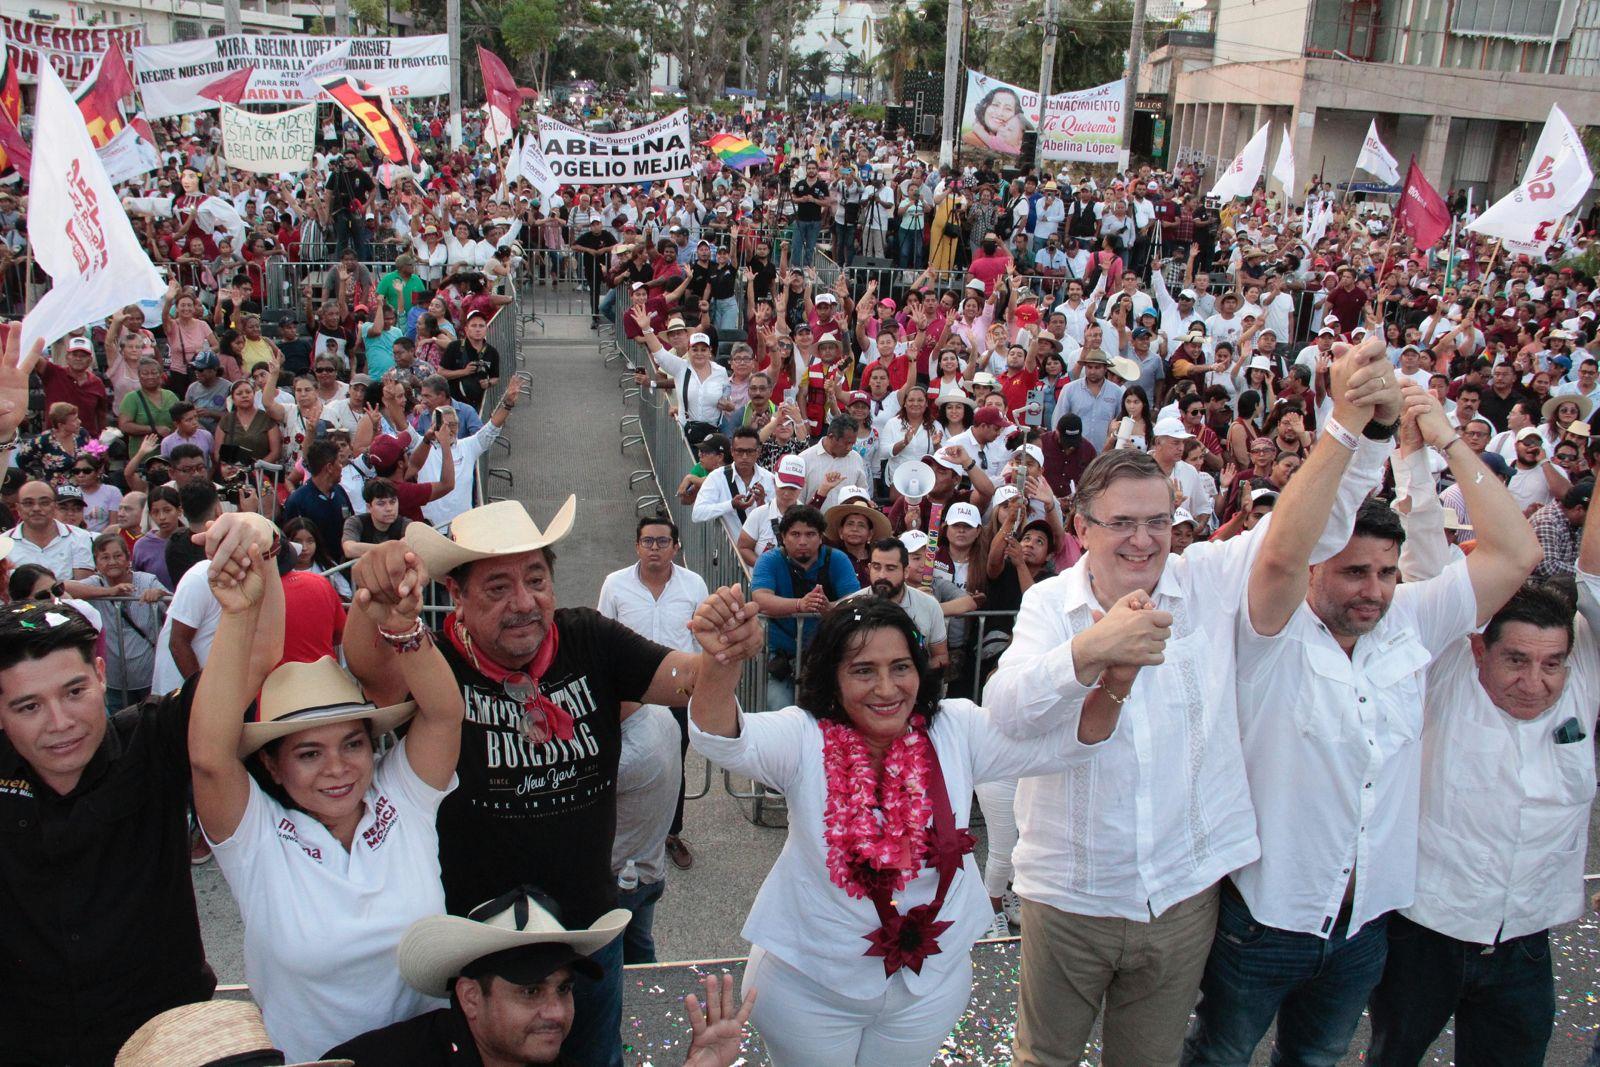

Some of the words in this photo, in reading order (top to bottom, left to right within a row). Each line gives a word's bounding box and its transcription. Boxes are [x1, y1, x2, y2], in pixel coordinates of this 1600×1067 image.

[215, 37, 252, 58] MTRA.
[254, 38, 299, 57] ABELINA
[140, 68, 176, 84] RECIBE
[178, 60, 225, 79] NUESTRO
[227, 57, 260, 71] APOYO
[263, 58, 290, 71] PARA
[292, 58, 305, 71] LA
[374, 58, 386, 70] DE
[388, 58, 400, 69] TU
[255, 129, 277, 143] CON
[647, 122, 670, 136] Mejor
[1043, 115, 1061, 131] Te
[1062, 115, 1116, 137] Queremos
[228, 143, 279, 161] ABELINA
[545, 134, 685, 156] ABELINA
[1043, 139, 1083, 152] Abelina
[1085, 139, 1115, 156] López
[550, 160, 627, 177] OGELIO
[634, 153, 691, 176] MEJÍA
[957, 507, 972, 516] TAJA
[486, 722, 600, 769] BUILDING
[516, 774, 546, 795] New
[547, 764, 578, 789] York
[472, 799, 510, 809] TAKE
[525, 801, 538, 809] IN
[552, 794, 575, 805] THE
